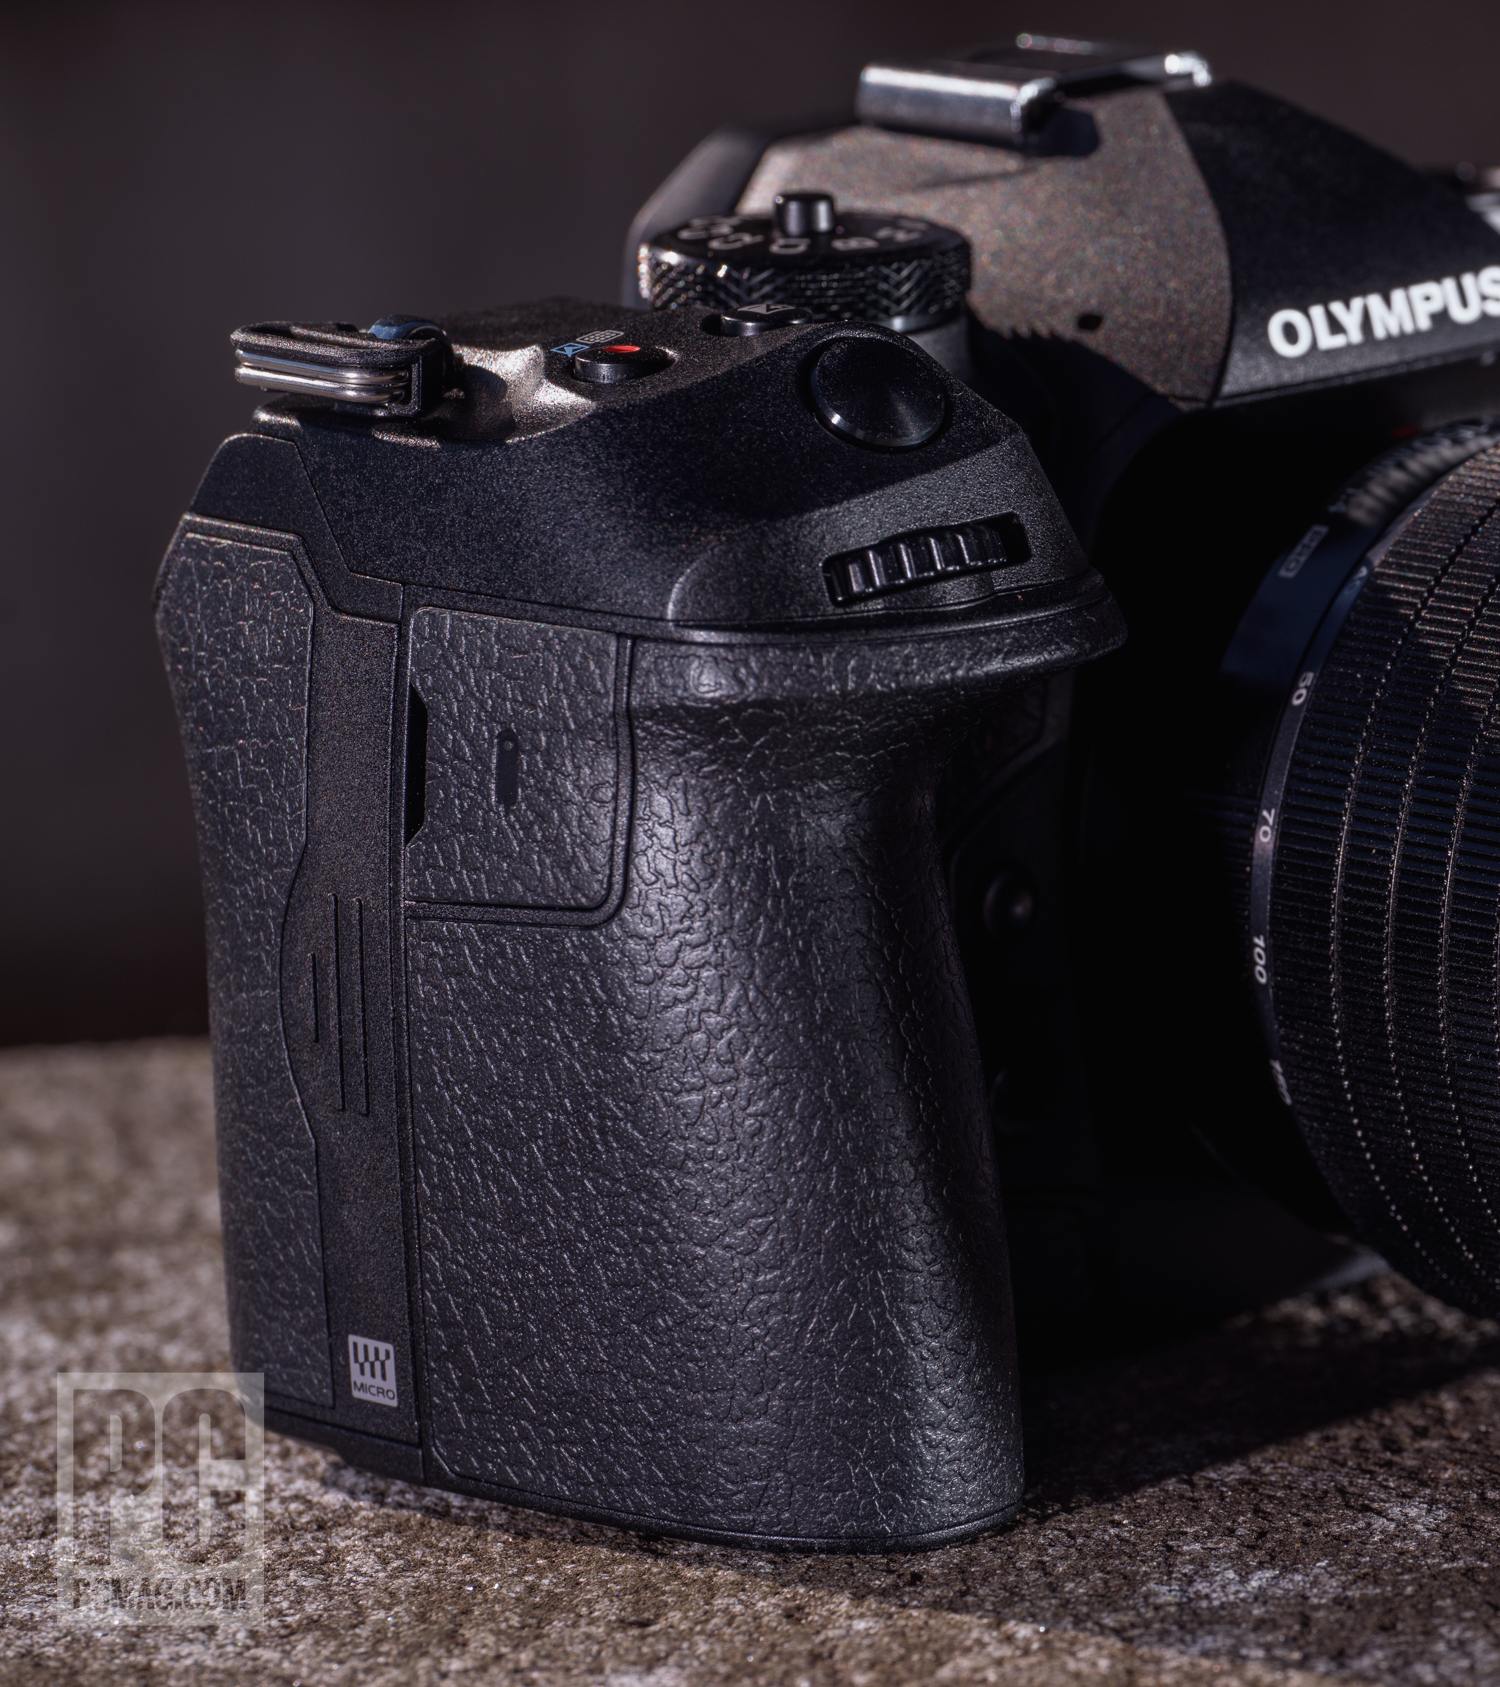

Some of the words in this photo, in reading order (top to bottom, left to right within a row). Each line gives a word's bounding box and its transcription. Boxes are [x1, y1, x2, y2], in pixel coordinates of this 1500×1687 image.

[1292, 671, 1314, 706] 50
[1259, 807, 1276, 843] 70
[1252, 934, 1269, 985] 100
[353, 1380, 396, 1401] MICRO
